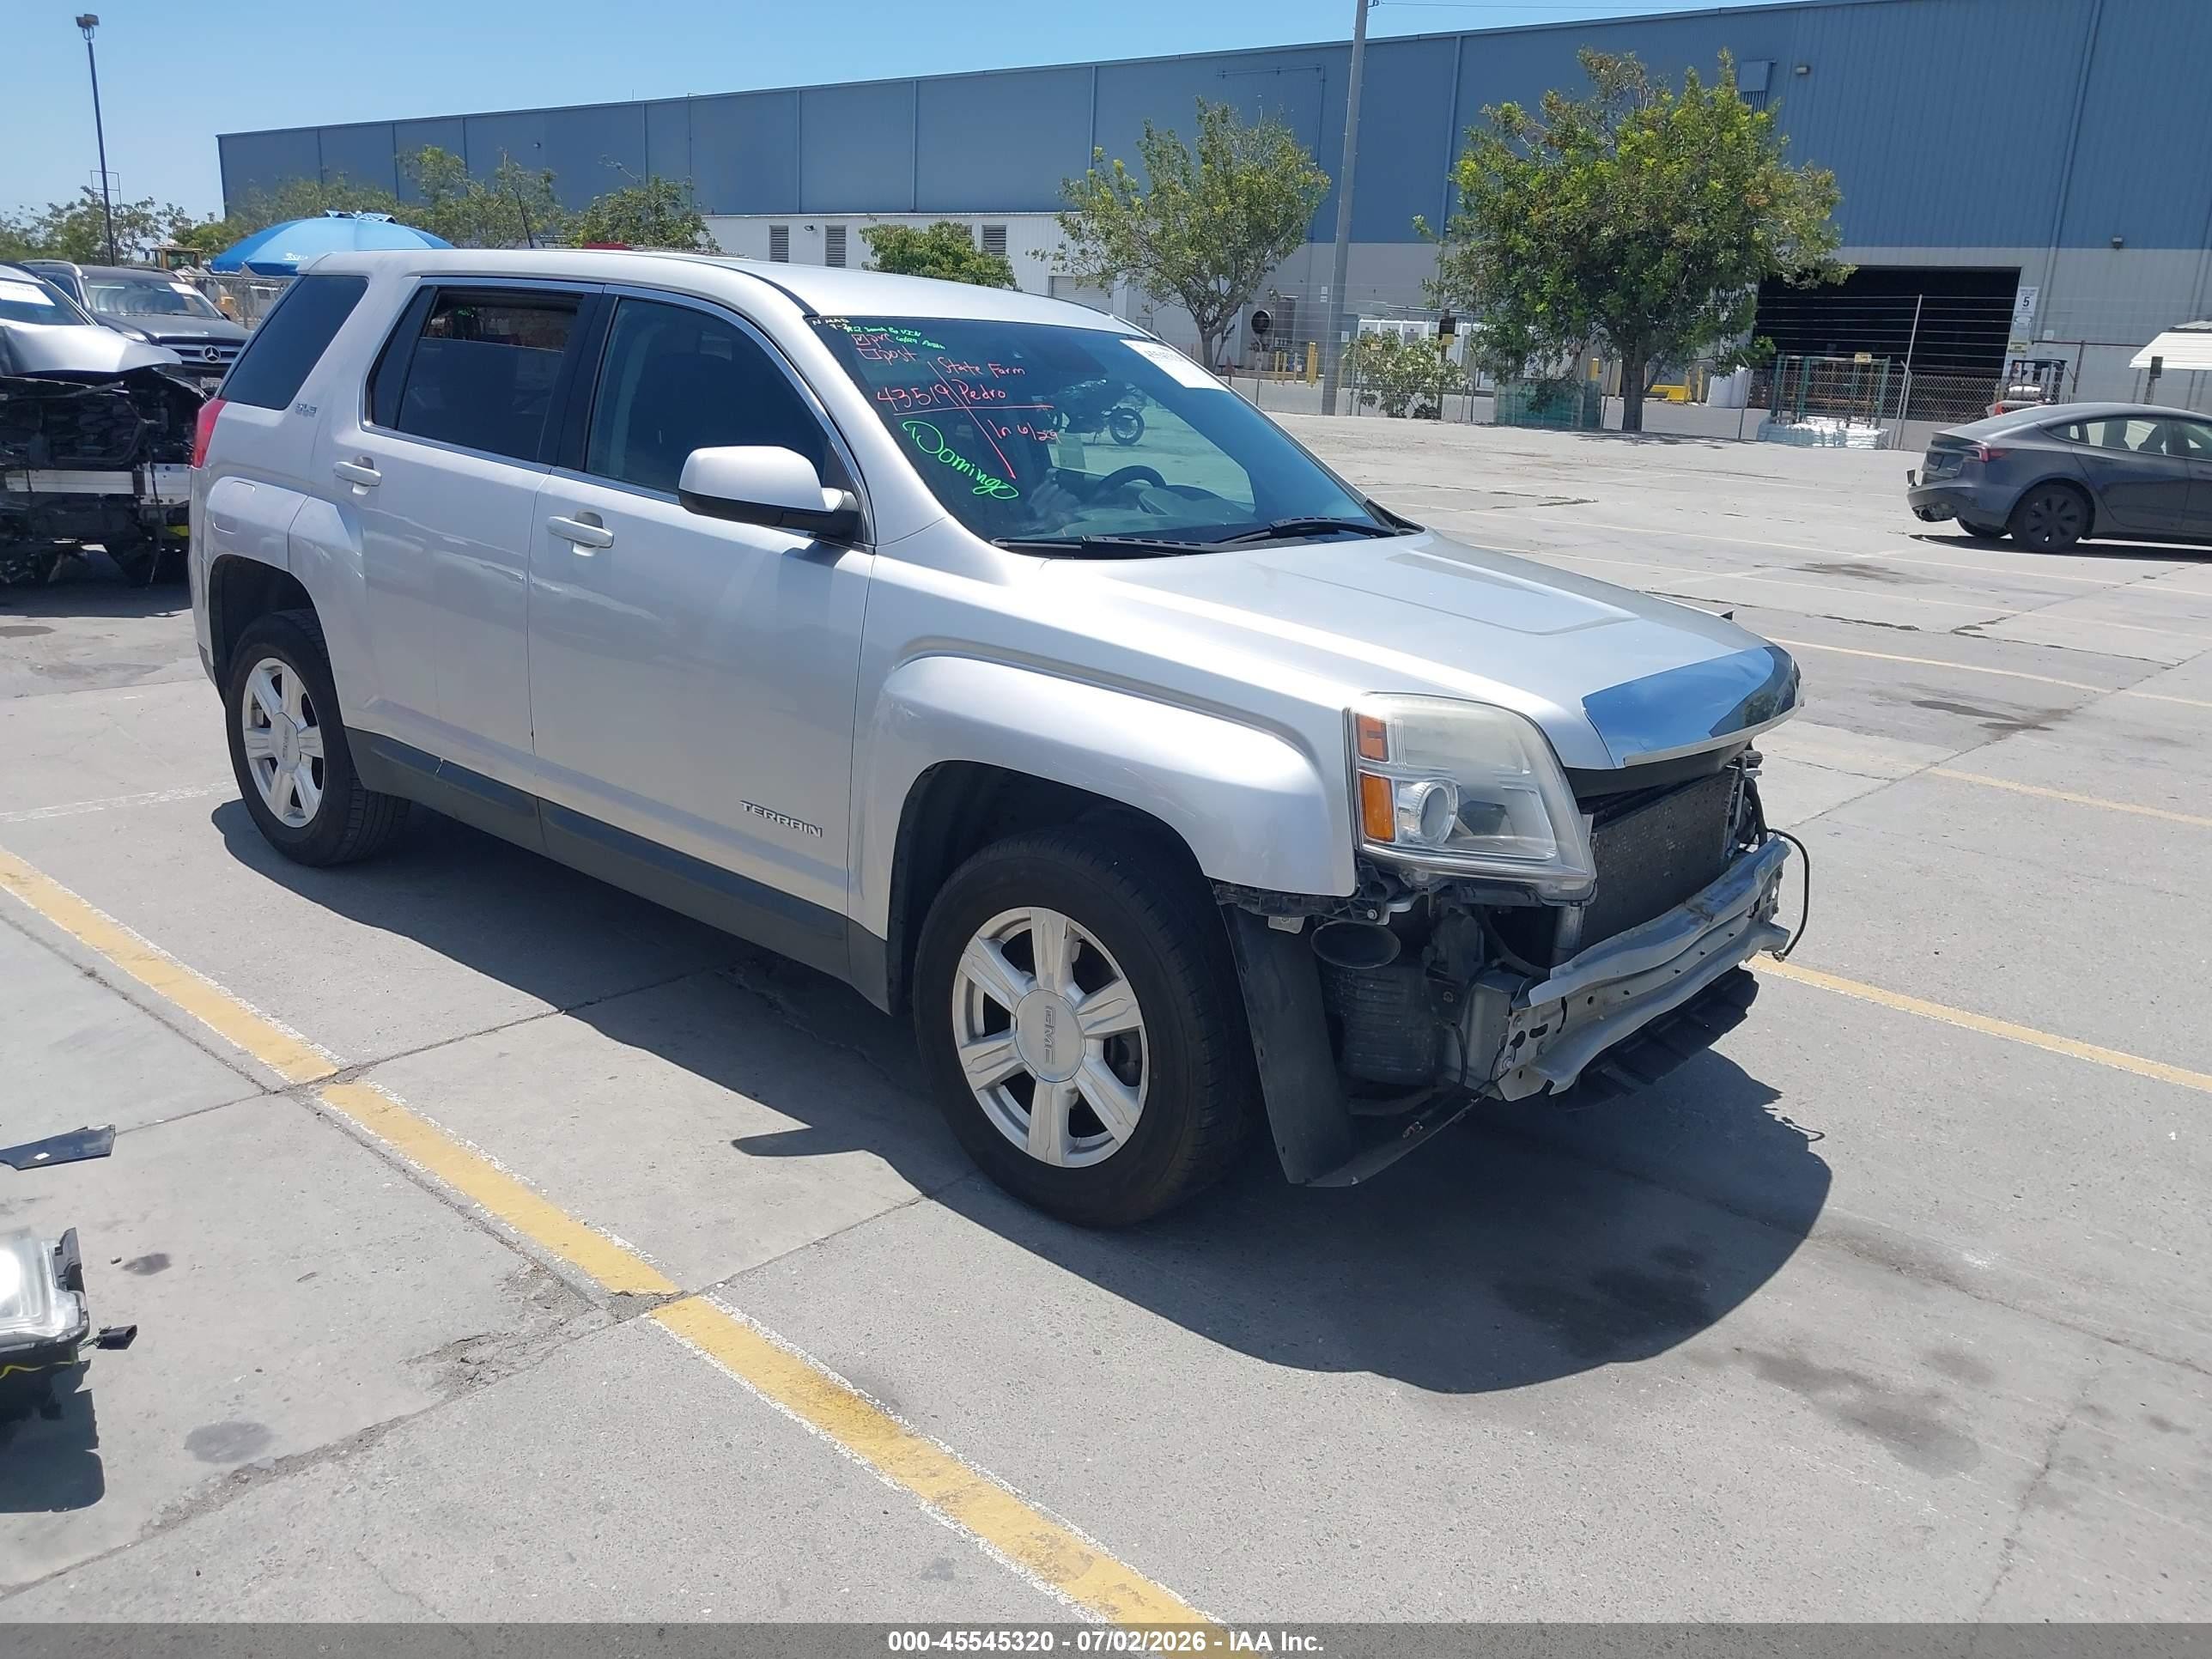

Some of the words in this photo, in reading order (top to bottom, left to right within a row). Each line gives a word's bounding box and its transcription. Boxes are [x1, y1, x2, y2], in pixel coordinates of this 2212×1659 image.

[2022, 296, 2030, 307] 5
[902, 329, 921, 337] VIN
[880, 345, 918, 365] post
[938, 356, 983, 376] State
[988, 363, 1025, 378] Farm
[877, 383, 959, 412] 43519
[951, 379, 1006, 405] Pedro
[1017, 422, 1062, 444] 6/29
[902, 420, 1019, 500] Domingo
[739, 799, 823, 838] TERRAIN
[1044, 1006, 1056, 1065] GMC
